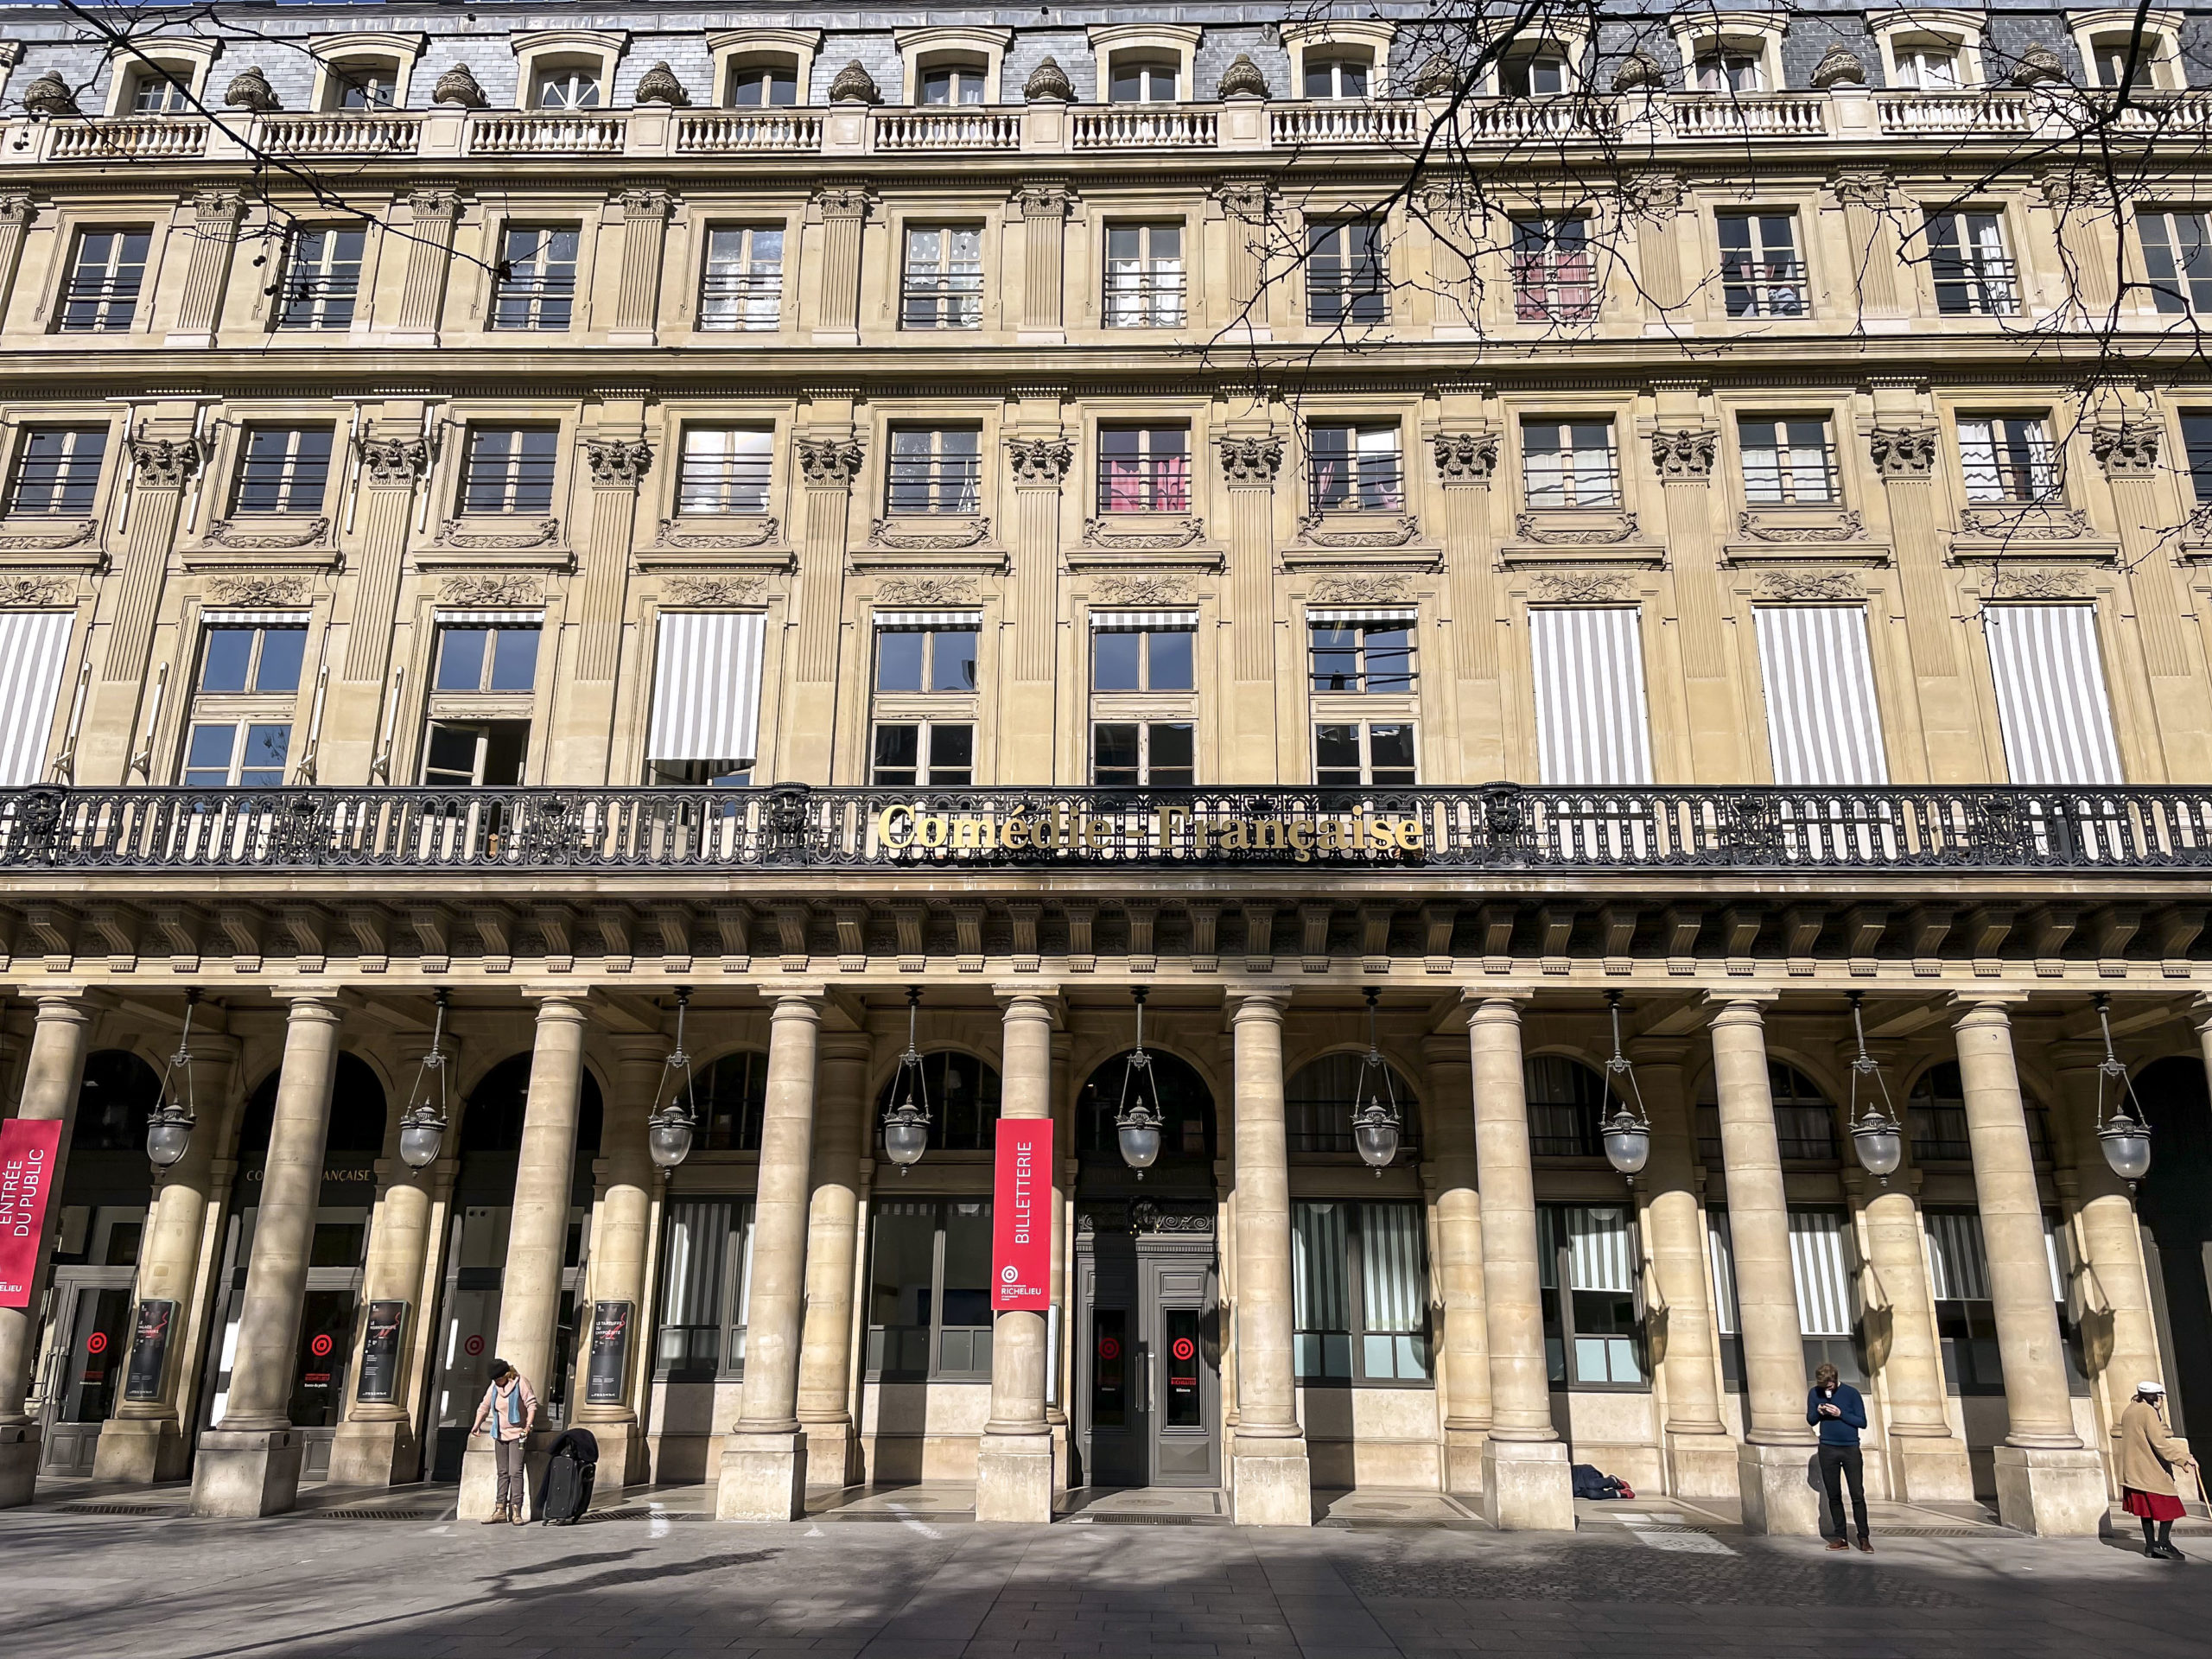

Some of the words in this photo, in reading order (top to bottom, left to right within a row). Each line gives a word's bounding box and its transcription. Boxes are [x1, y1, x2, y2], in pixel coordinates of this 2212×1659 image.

[878, 804, 1112, 849] Comédie
[1154, 804, 1423, 862] Française
[0, 1160, 22, 1224] ENTRÉE
[21, 1149, 44, 1207] PUBLIC
[322, 1169, 372, 1182] ANÇAISE
[1014, 1141, 1032, 1243] BILLETTERIE
[14, 1211, 32, 1236] DU
